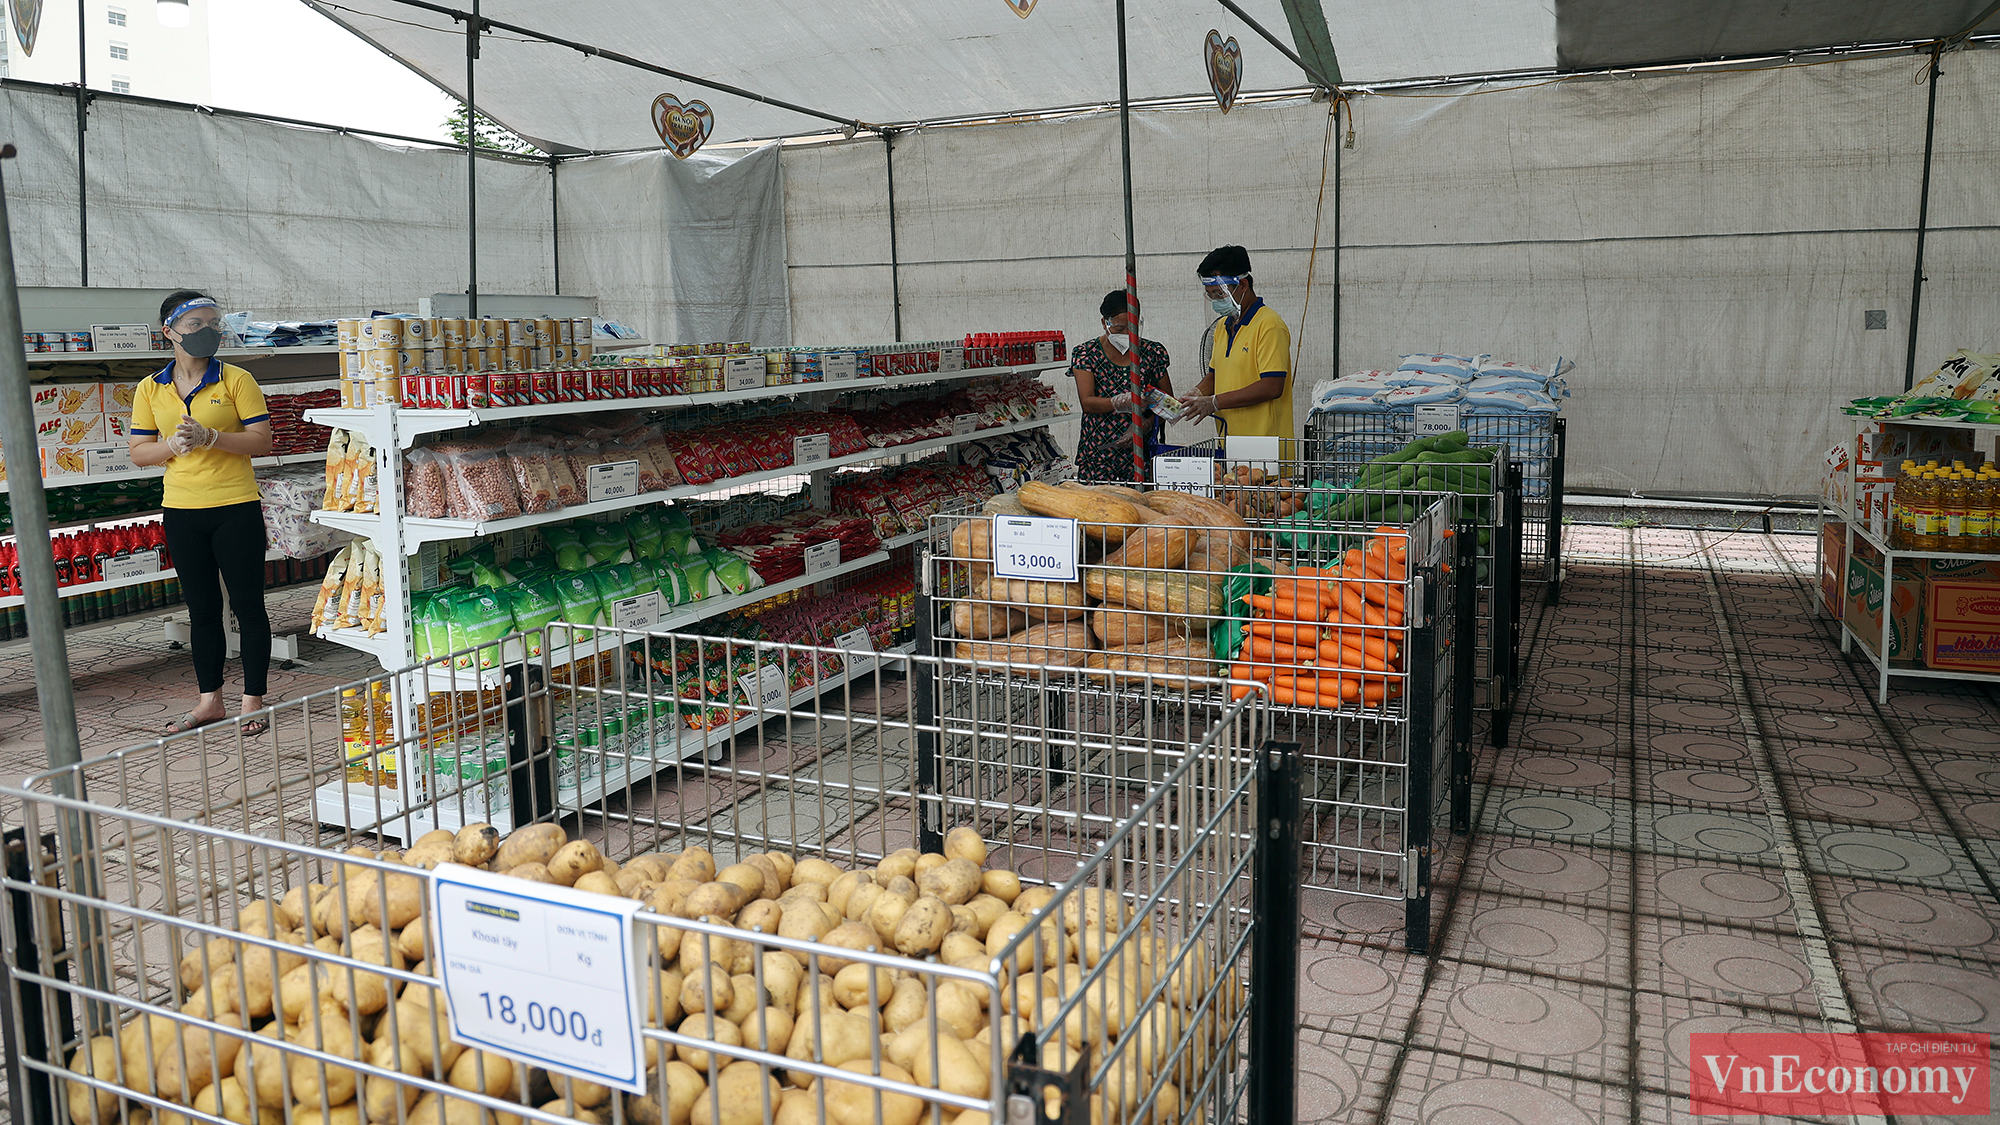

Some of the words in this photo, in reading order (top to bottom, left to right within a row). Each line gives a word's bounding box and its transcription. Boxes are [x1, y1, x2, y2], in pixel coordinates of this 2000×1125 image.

[113, 342, 137, 350] 18,000đ
[34, 387, 58, 404] AFC
[37, 417, 62, 435] AFC
[108, 417, 124, 437] AFC
[1423, 423, 1452, 432] 78,000đ
[105, 464, 129, 472] 28,000đ
[604, 485, 625, 495] 40,000đ
[1009, 553, 1062, 570] 13,000đ
[122, 569, 145, 578] 13,000đ
[1972, 567, 1987, 576] CAY
[629, 617, 648, 628] 24,000đ
[1954, 634, 1985, 650] Hảo
[761, 689, 782, 704] 3,000đ
[472, 928, 500, 945] Khoai
[502, 936, 518, 951] tây
[557, 924, 577, 938] ĐƠN
[577, 929, 587, 940] VỊ
[587, 931, 609, 943] TÍNH
[450, 960, 467, 973] ĐƠN
[467, 964, 482, 975] GIÁ
[577, 952, 593, 968] Kg
[479, 991, 603, 1047] 18,000đ
